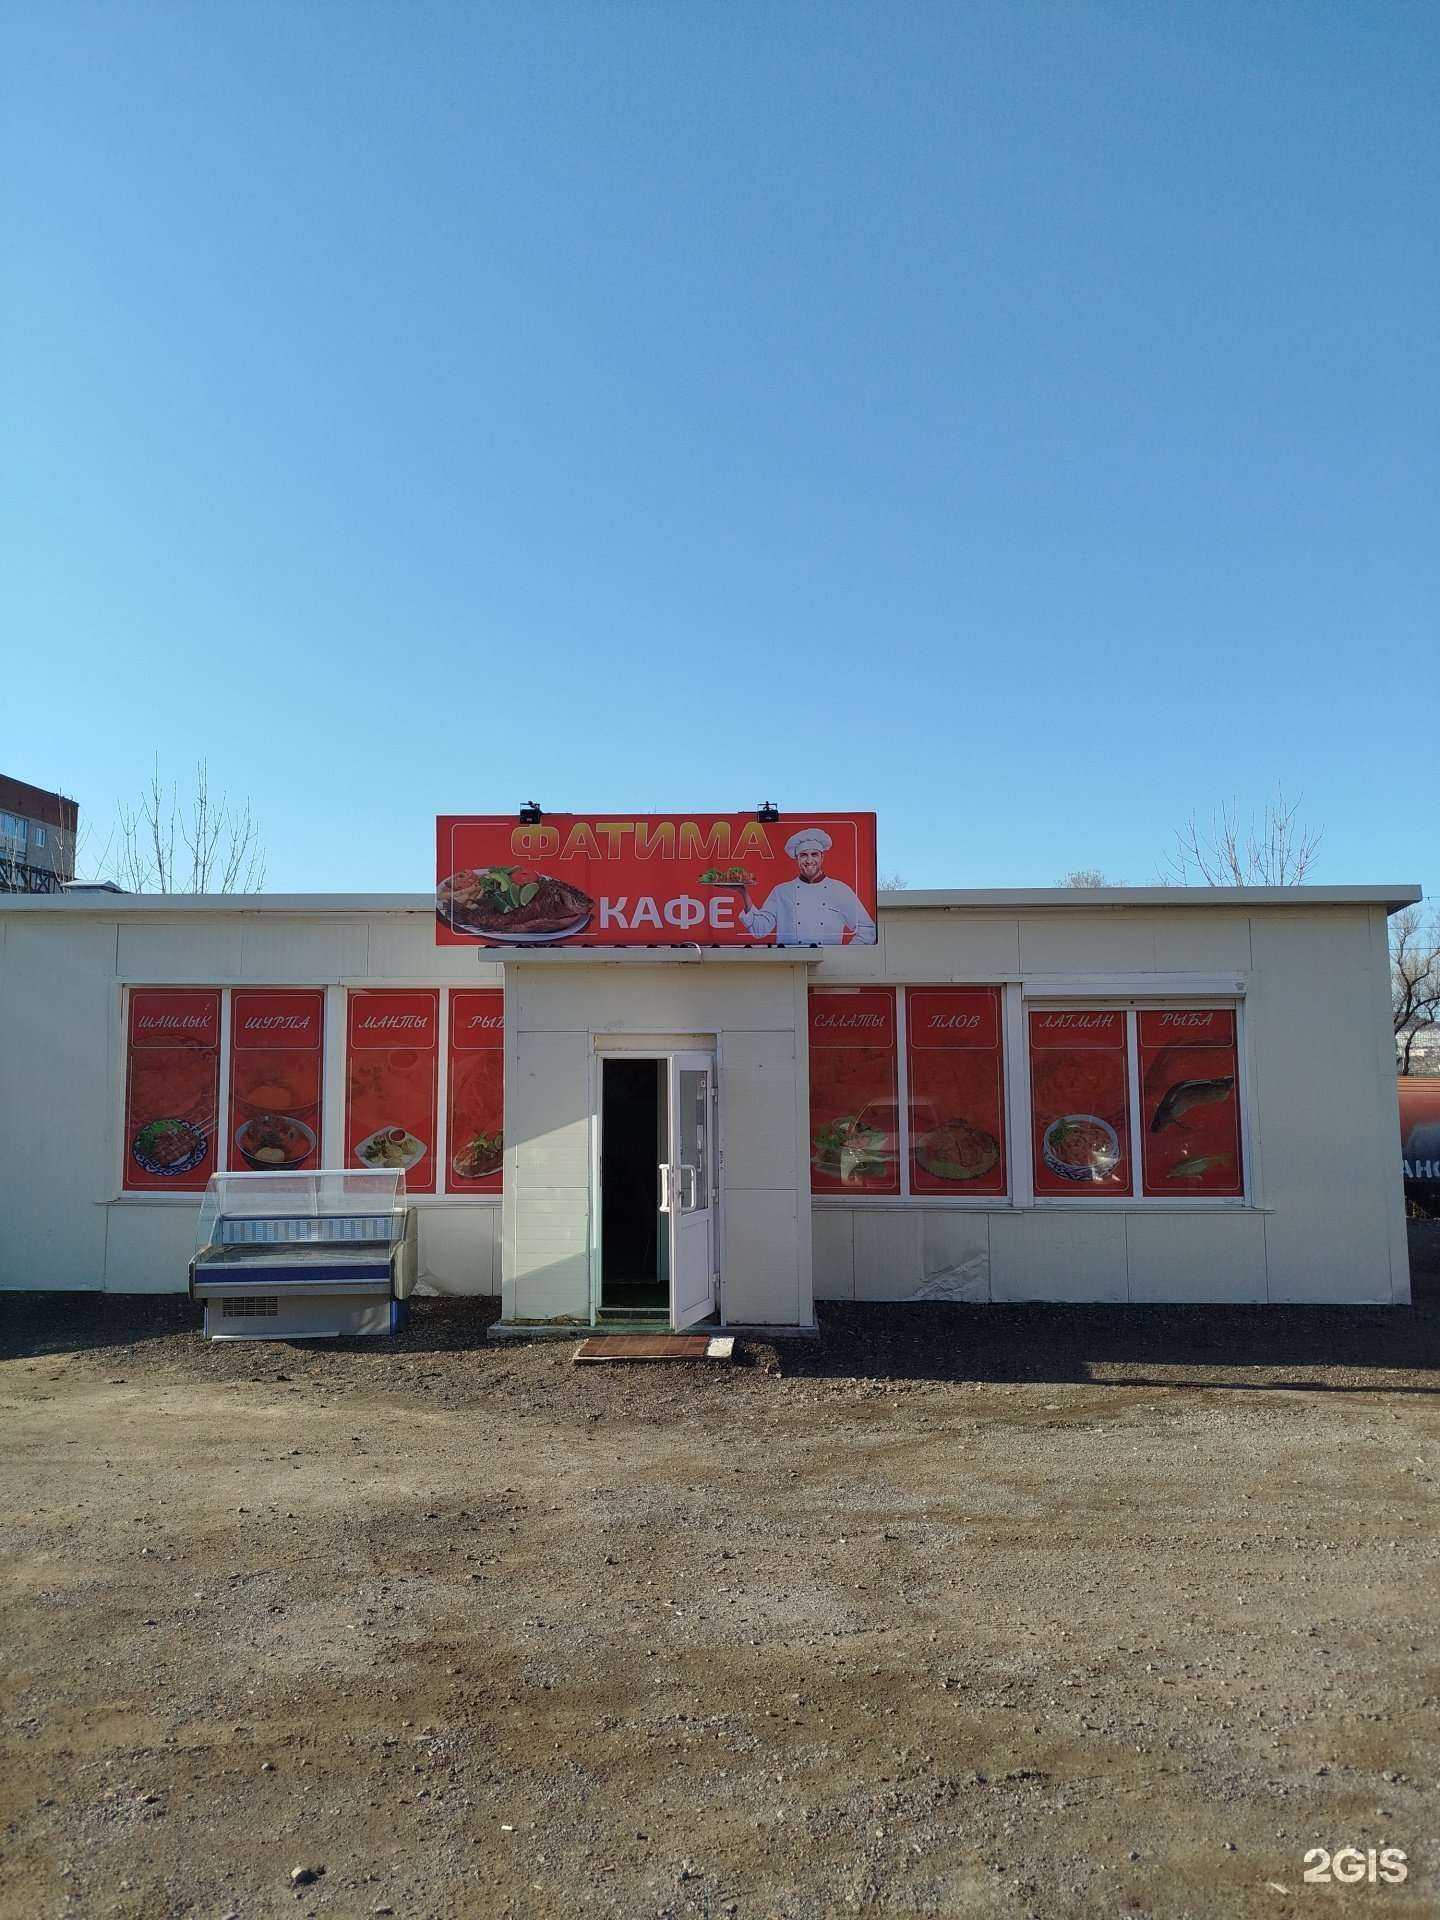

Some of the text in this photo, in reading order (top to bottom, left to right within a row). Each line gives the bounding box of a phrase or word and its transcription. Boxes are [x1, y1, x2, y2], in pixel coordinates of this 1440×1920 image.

[511, 822, 774, 860] ФАТИМА
[600, 894, 735, 930] КАФЕ
[137, 1015, 212, 1029] ШАШЛЫК
[244, 1015, 311, 1029] ШУРПА
[358, 1015, 429, 1029] МАНТЫ
[813, 1014, 886, 1028] САЛАТЫ
[929, 1014, 982, 1028] ПЛОВ
[1039, 1014, 1113, 1028] ЛАГМАН
[1158, 1012, 1213, 1027] РЫБА
